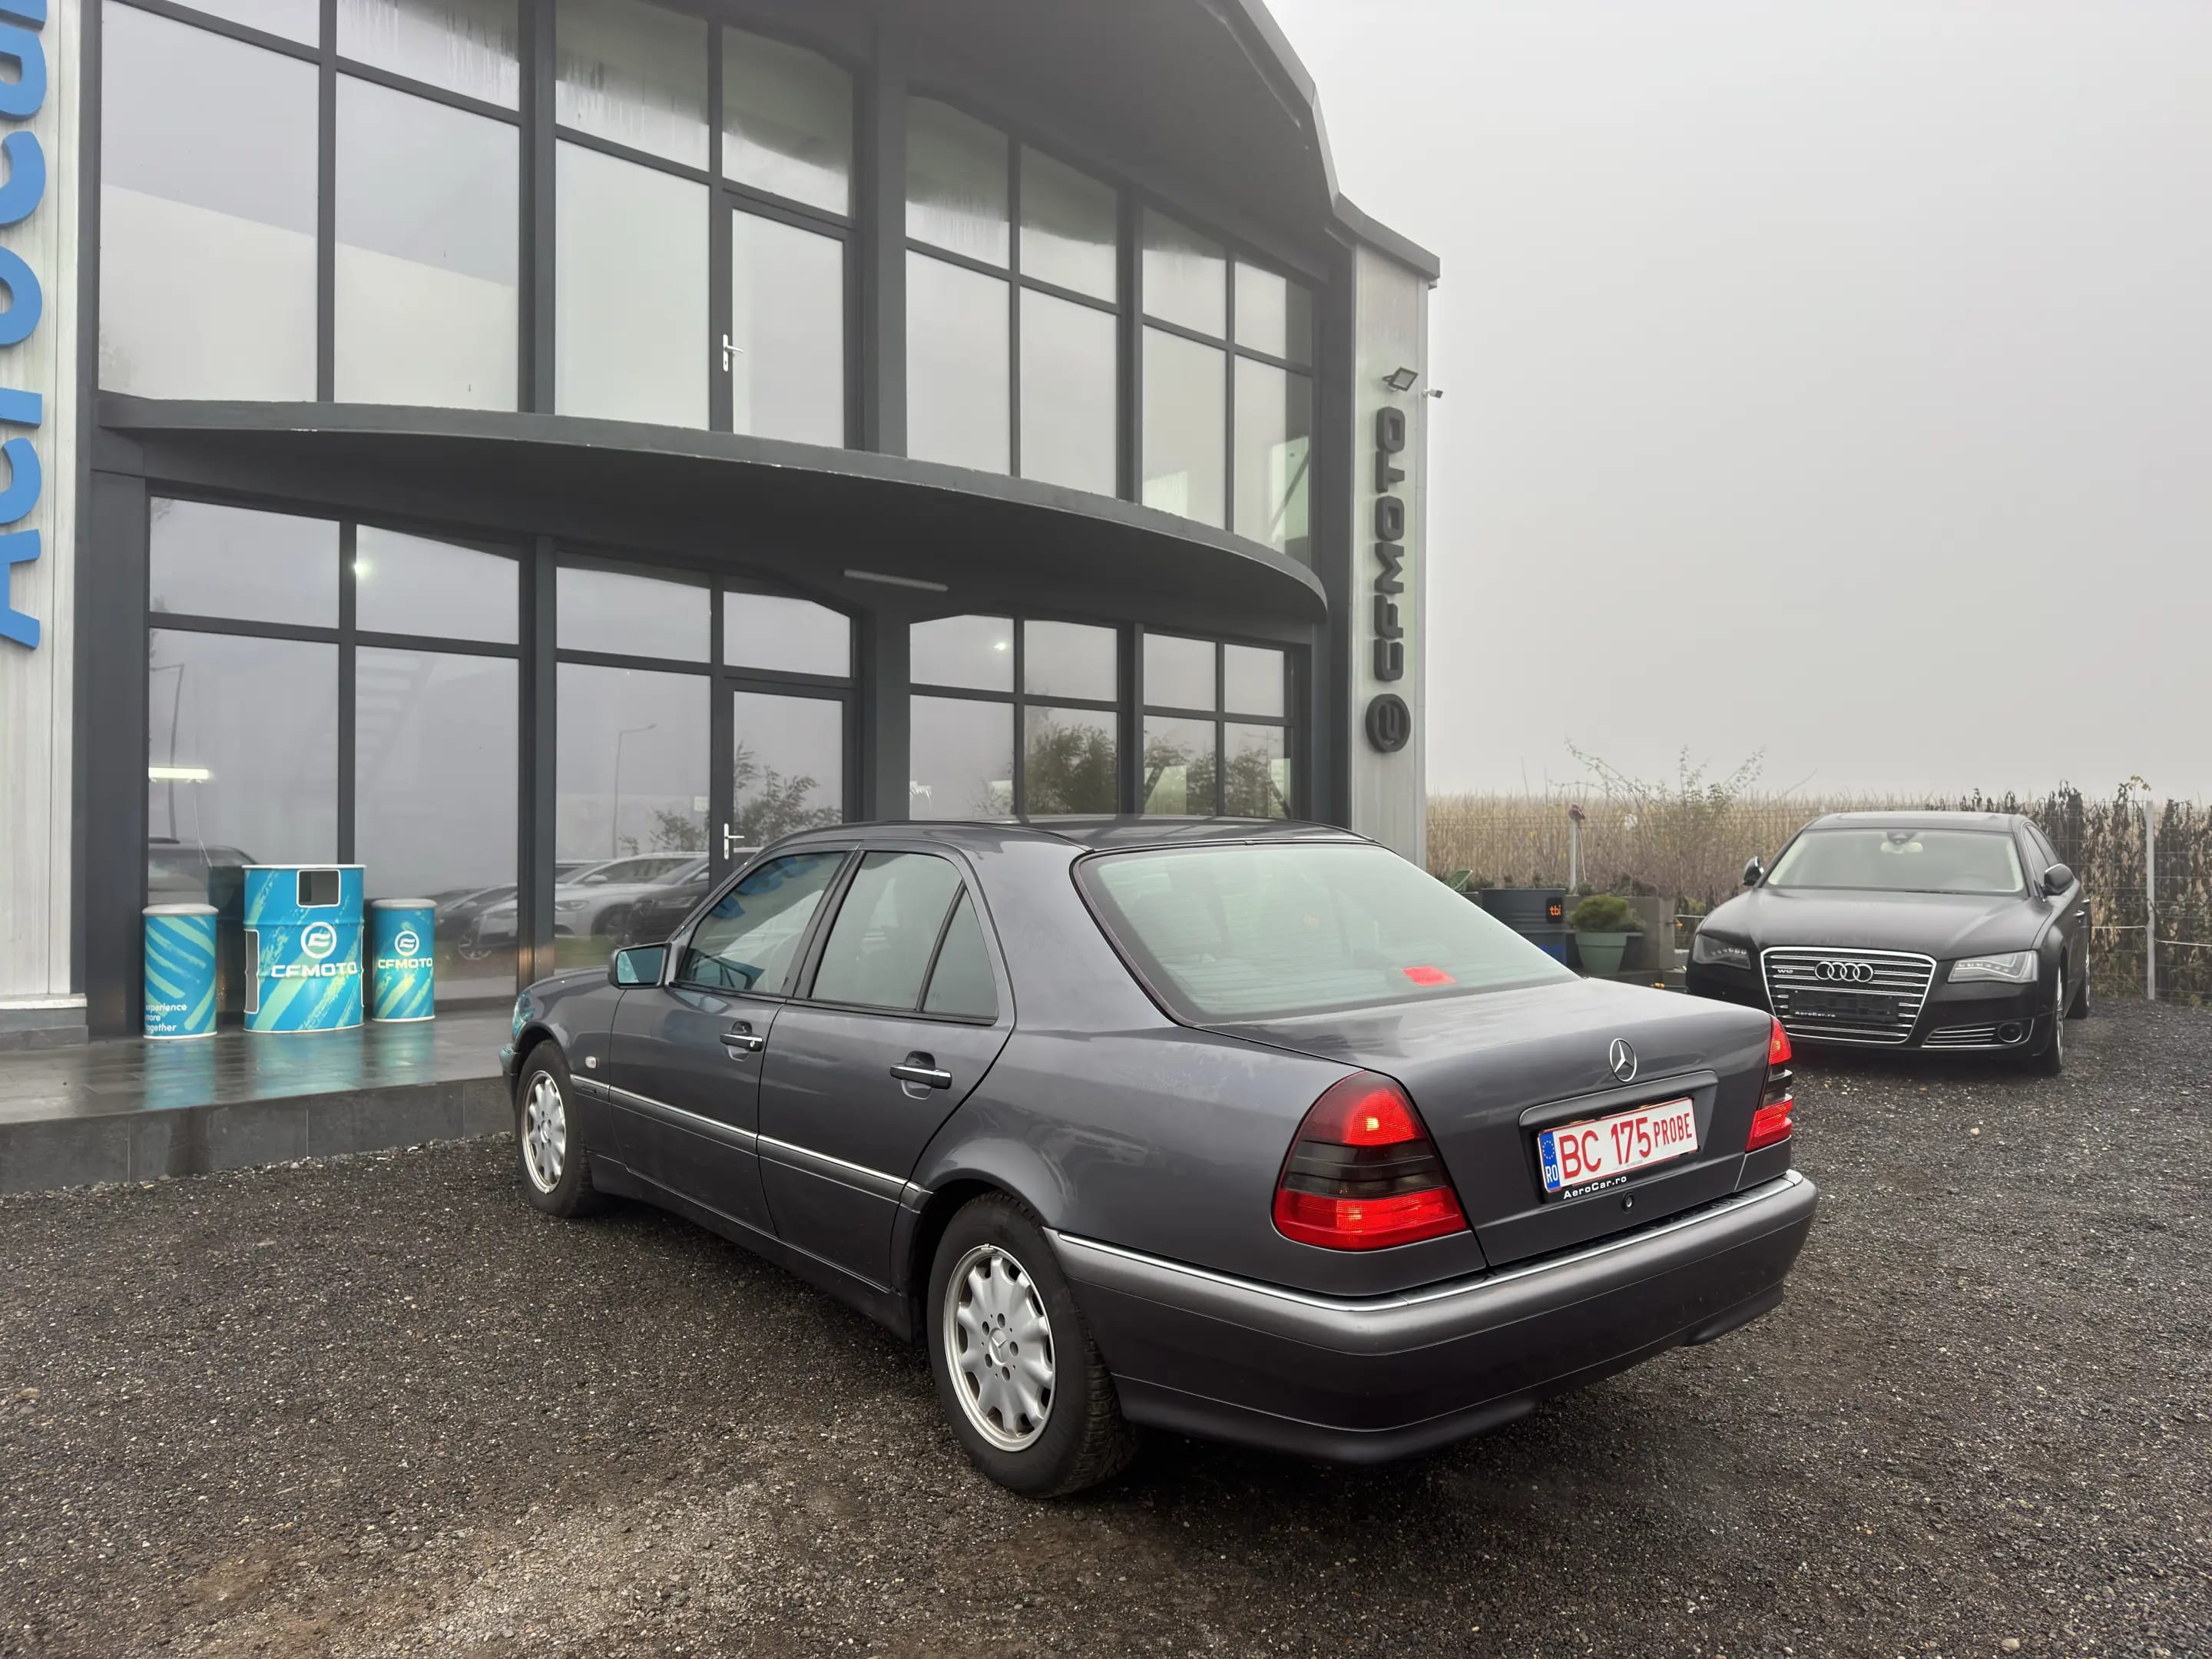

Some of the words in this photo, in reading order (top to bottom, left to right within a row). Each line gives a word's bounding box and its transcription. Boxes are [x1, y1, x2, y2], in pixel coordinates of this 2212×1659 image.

[1373, 406, 1406, 681] CFMOTO
[270, 961, 358, 978] CFMOTO
[378, 957, 433, 969] CFMOTO
[145, 1023, 177, 1034] ogether
[1558, 1130, 1601, 1180] BC
[1611, 1116, 1652, 1165] 175
[1654, 1112, 1693, 1148] PROBE
[1545, 1164, 1558, 1184] RO
[1563, 1176, 1627, 1200] AeroCar.ro
